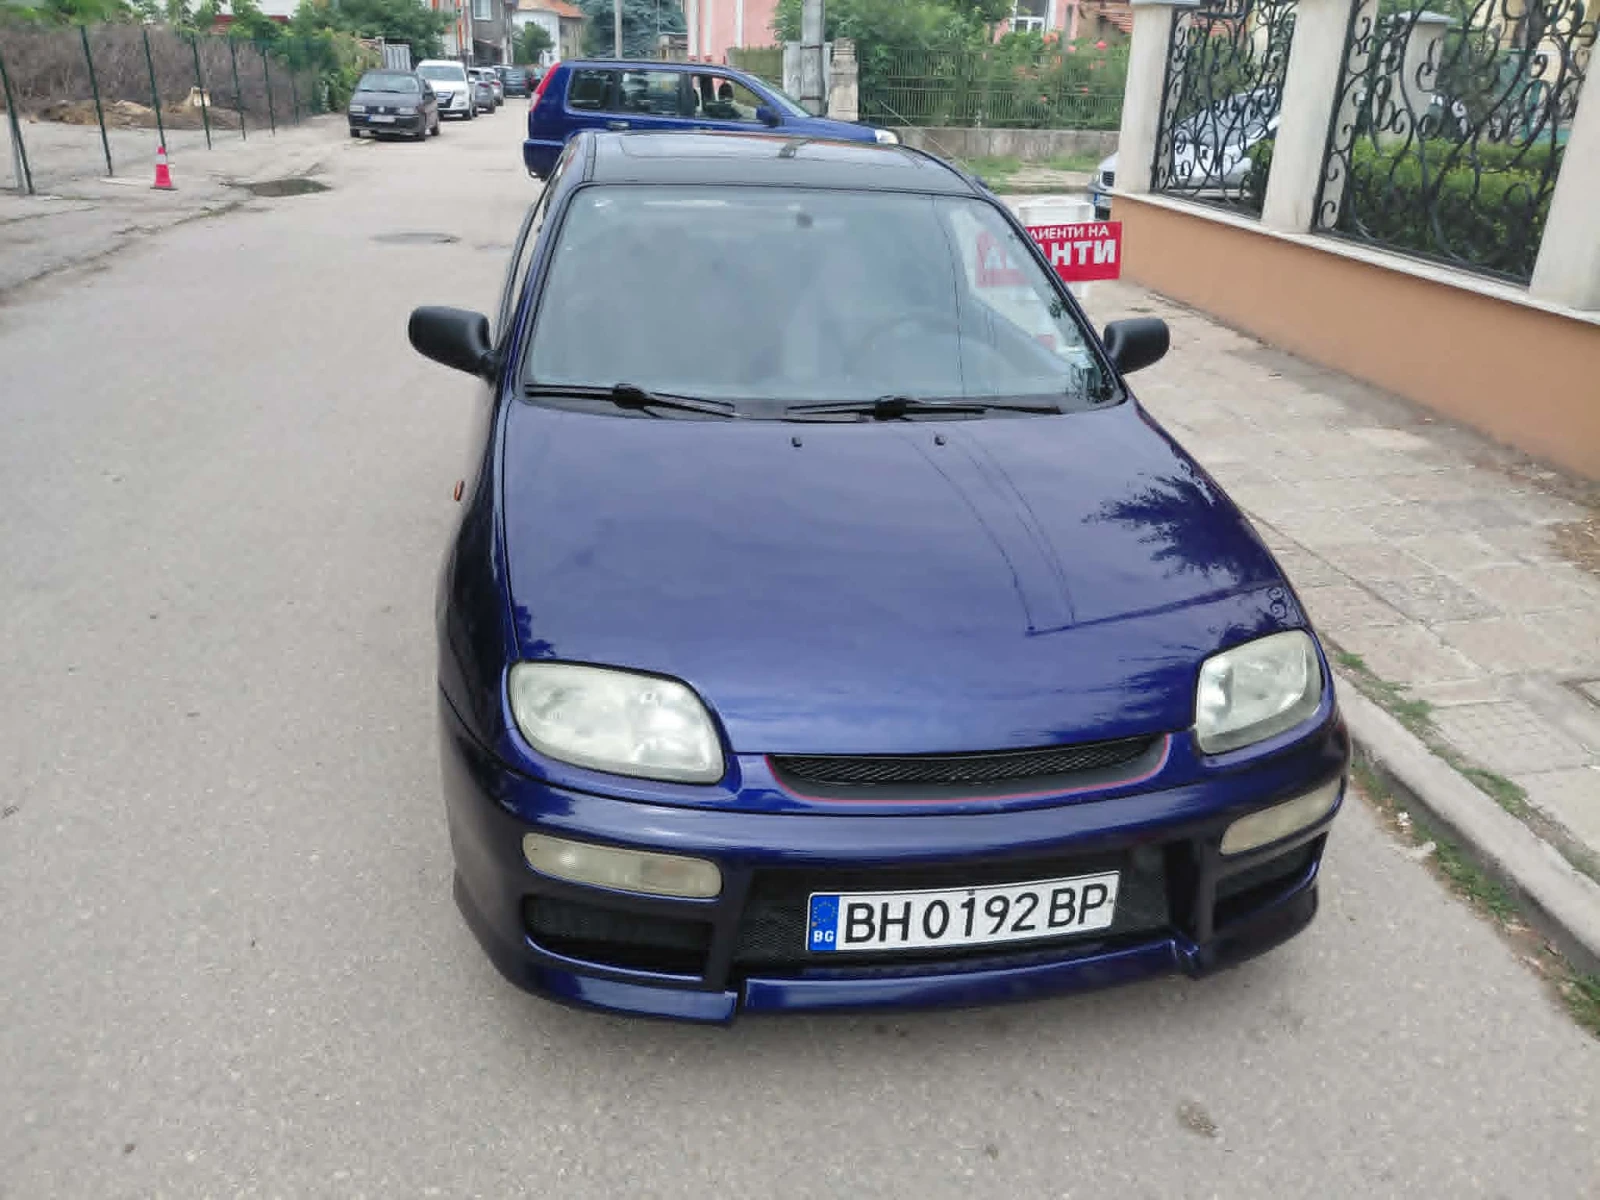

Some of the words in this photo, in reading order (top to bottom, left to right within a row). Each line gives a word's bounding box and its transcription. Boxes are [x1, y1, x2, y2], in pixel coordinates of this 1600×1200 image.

[1029, 226, 1085, 240] ЛИЕНТИ
[1088, 224, 1110, 238] НА
[844, 901, 912, 944] BH
[922, 891, 1040, 940] 0192
[1047, 882, 1109, 928] BP
[813, 930, 834, 943] BG
